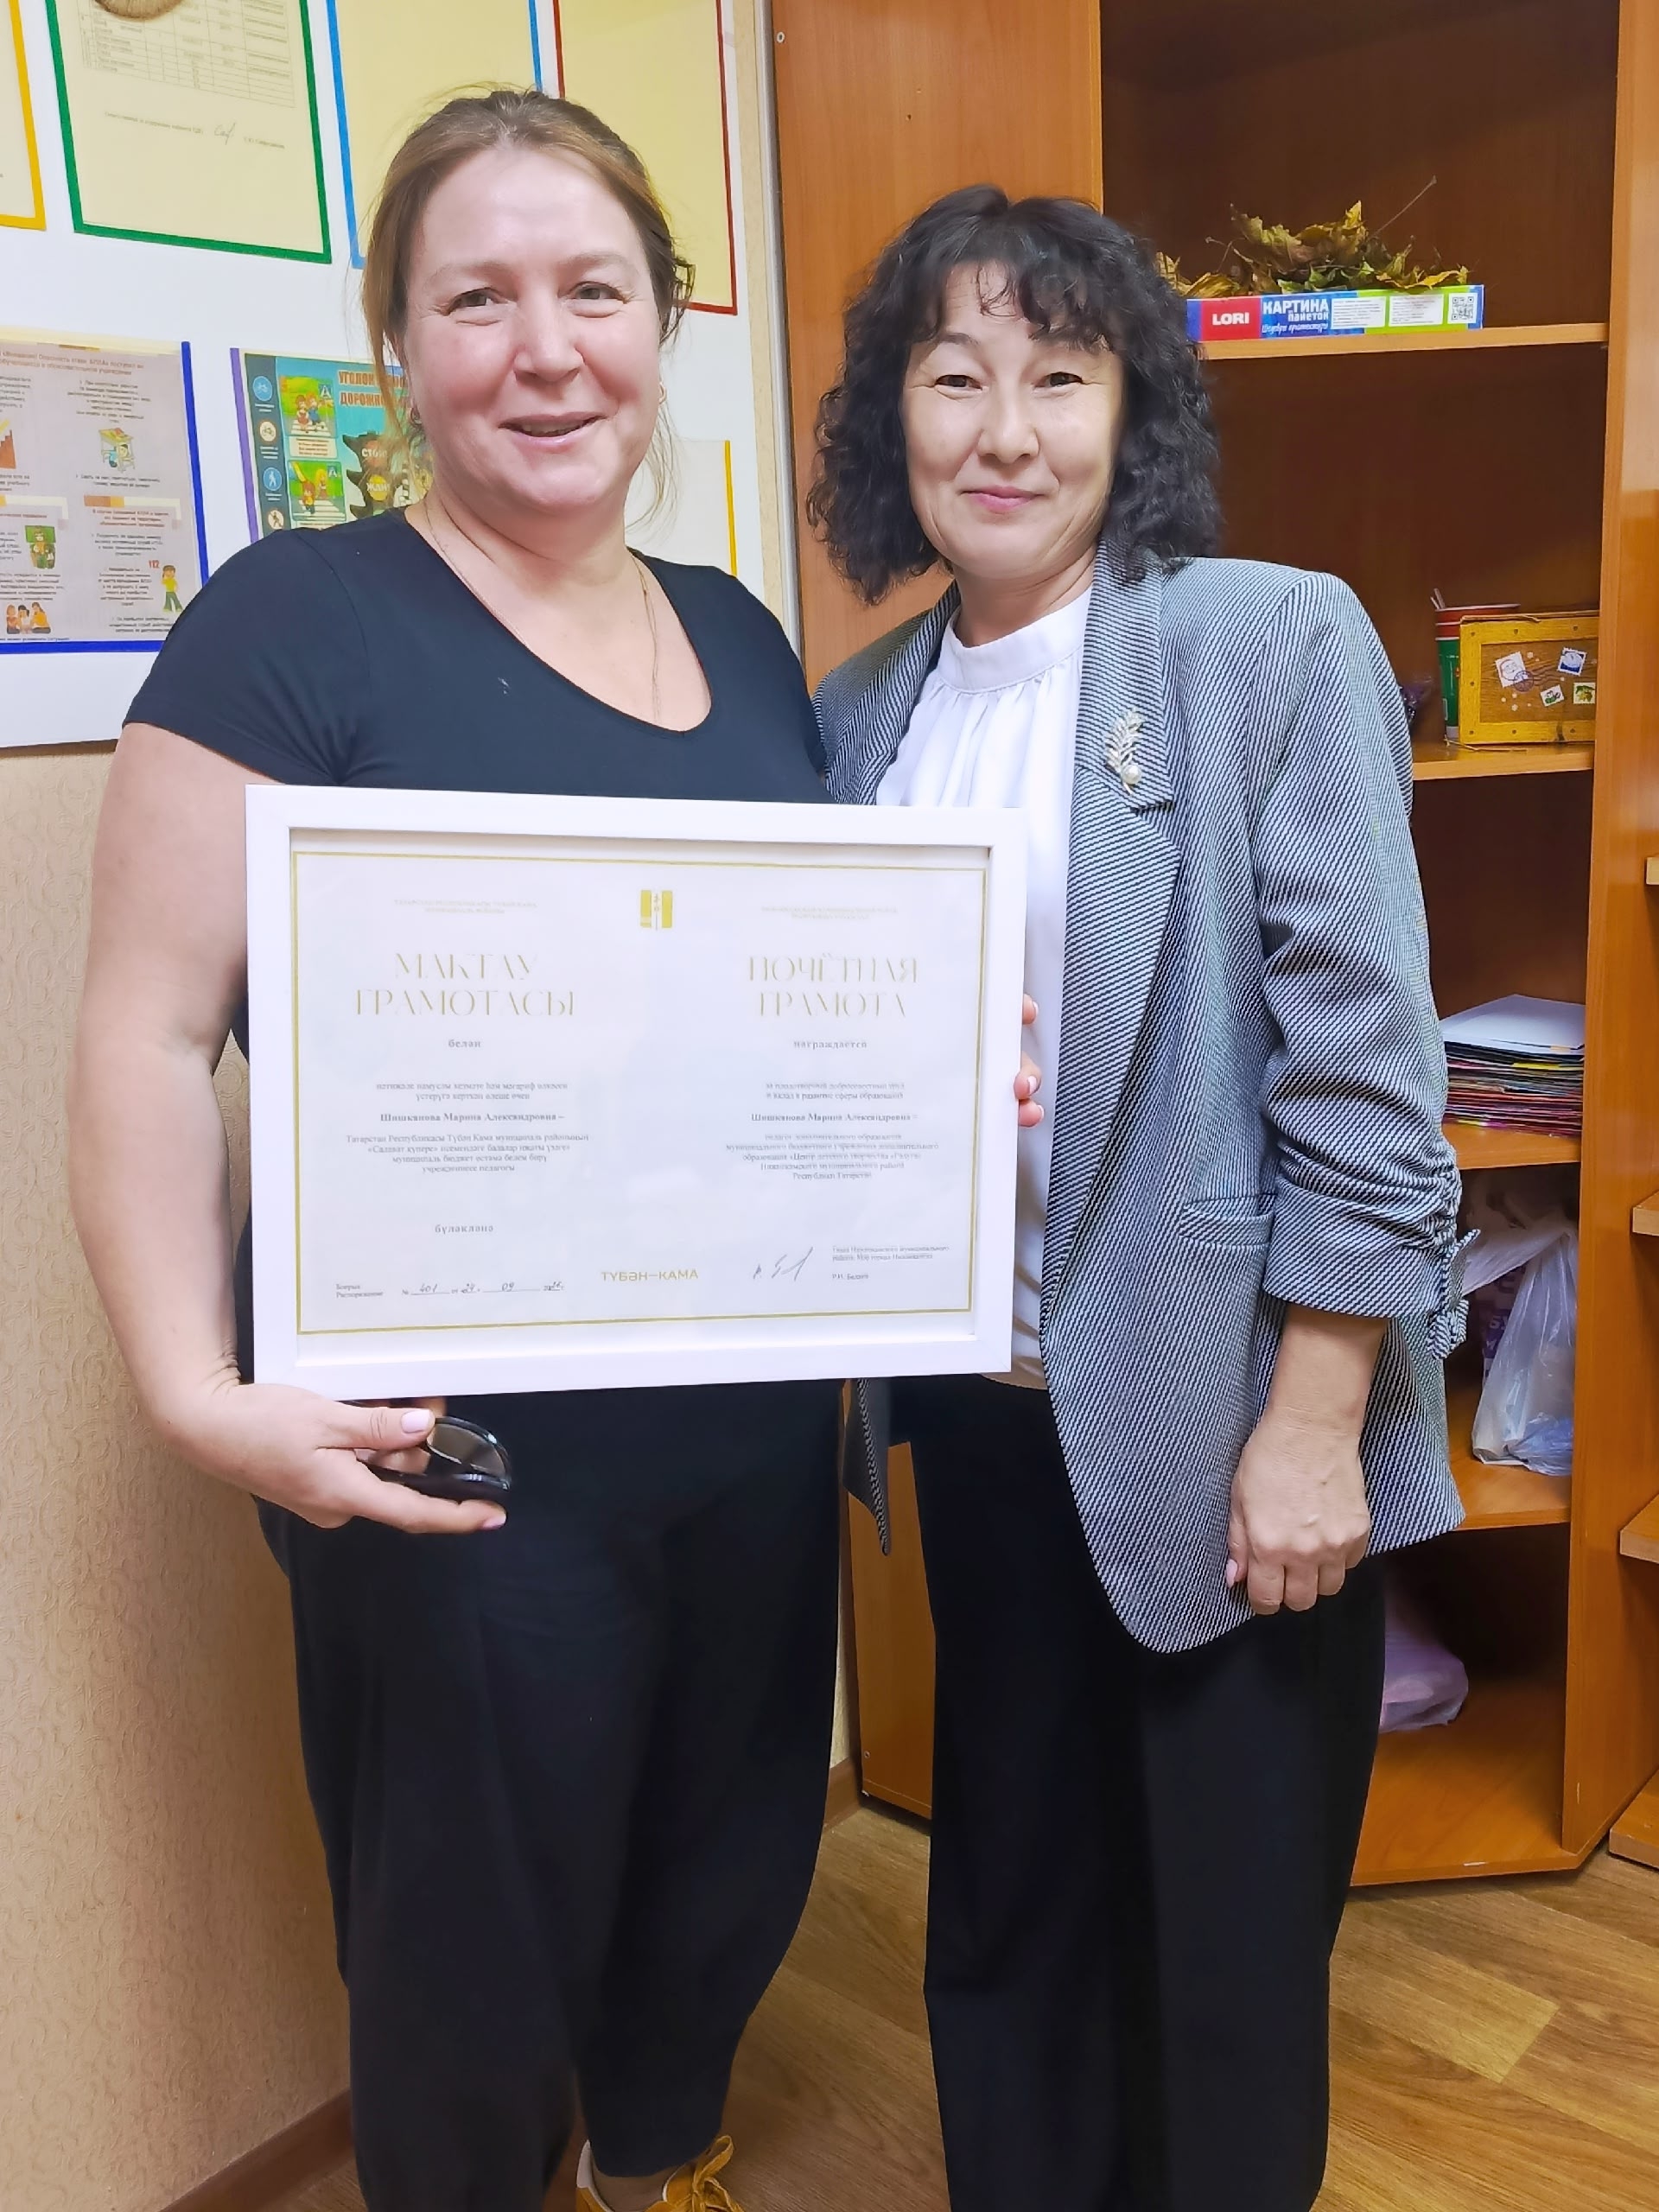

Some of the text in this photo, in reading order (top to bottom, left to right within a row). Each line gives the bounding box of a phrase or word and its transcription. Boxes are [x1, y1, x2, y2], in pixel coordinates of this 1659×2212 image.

[1262, 298, 1330, 315] КАРТИНА
[1212, 312, 1249, 326] LORI
[394, 952, 539, 980] МАКТАУ
[355, 989, 575, 1016] ГРАМОТАСЫ
[760, 991, 906, 1017] ГРАМОТА
[793, 1039, 868, 1050] награждается
[443, 1112, 481, 1122] Марина
